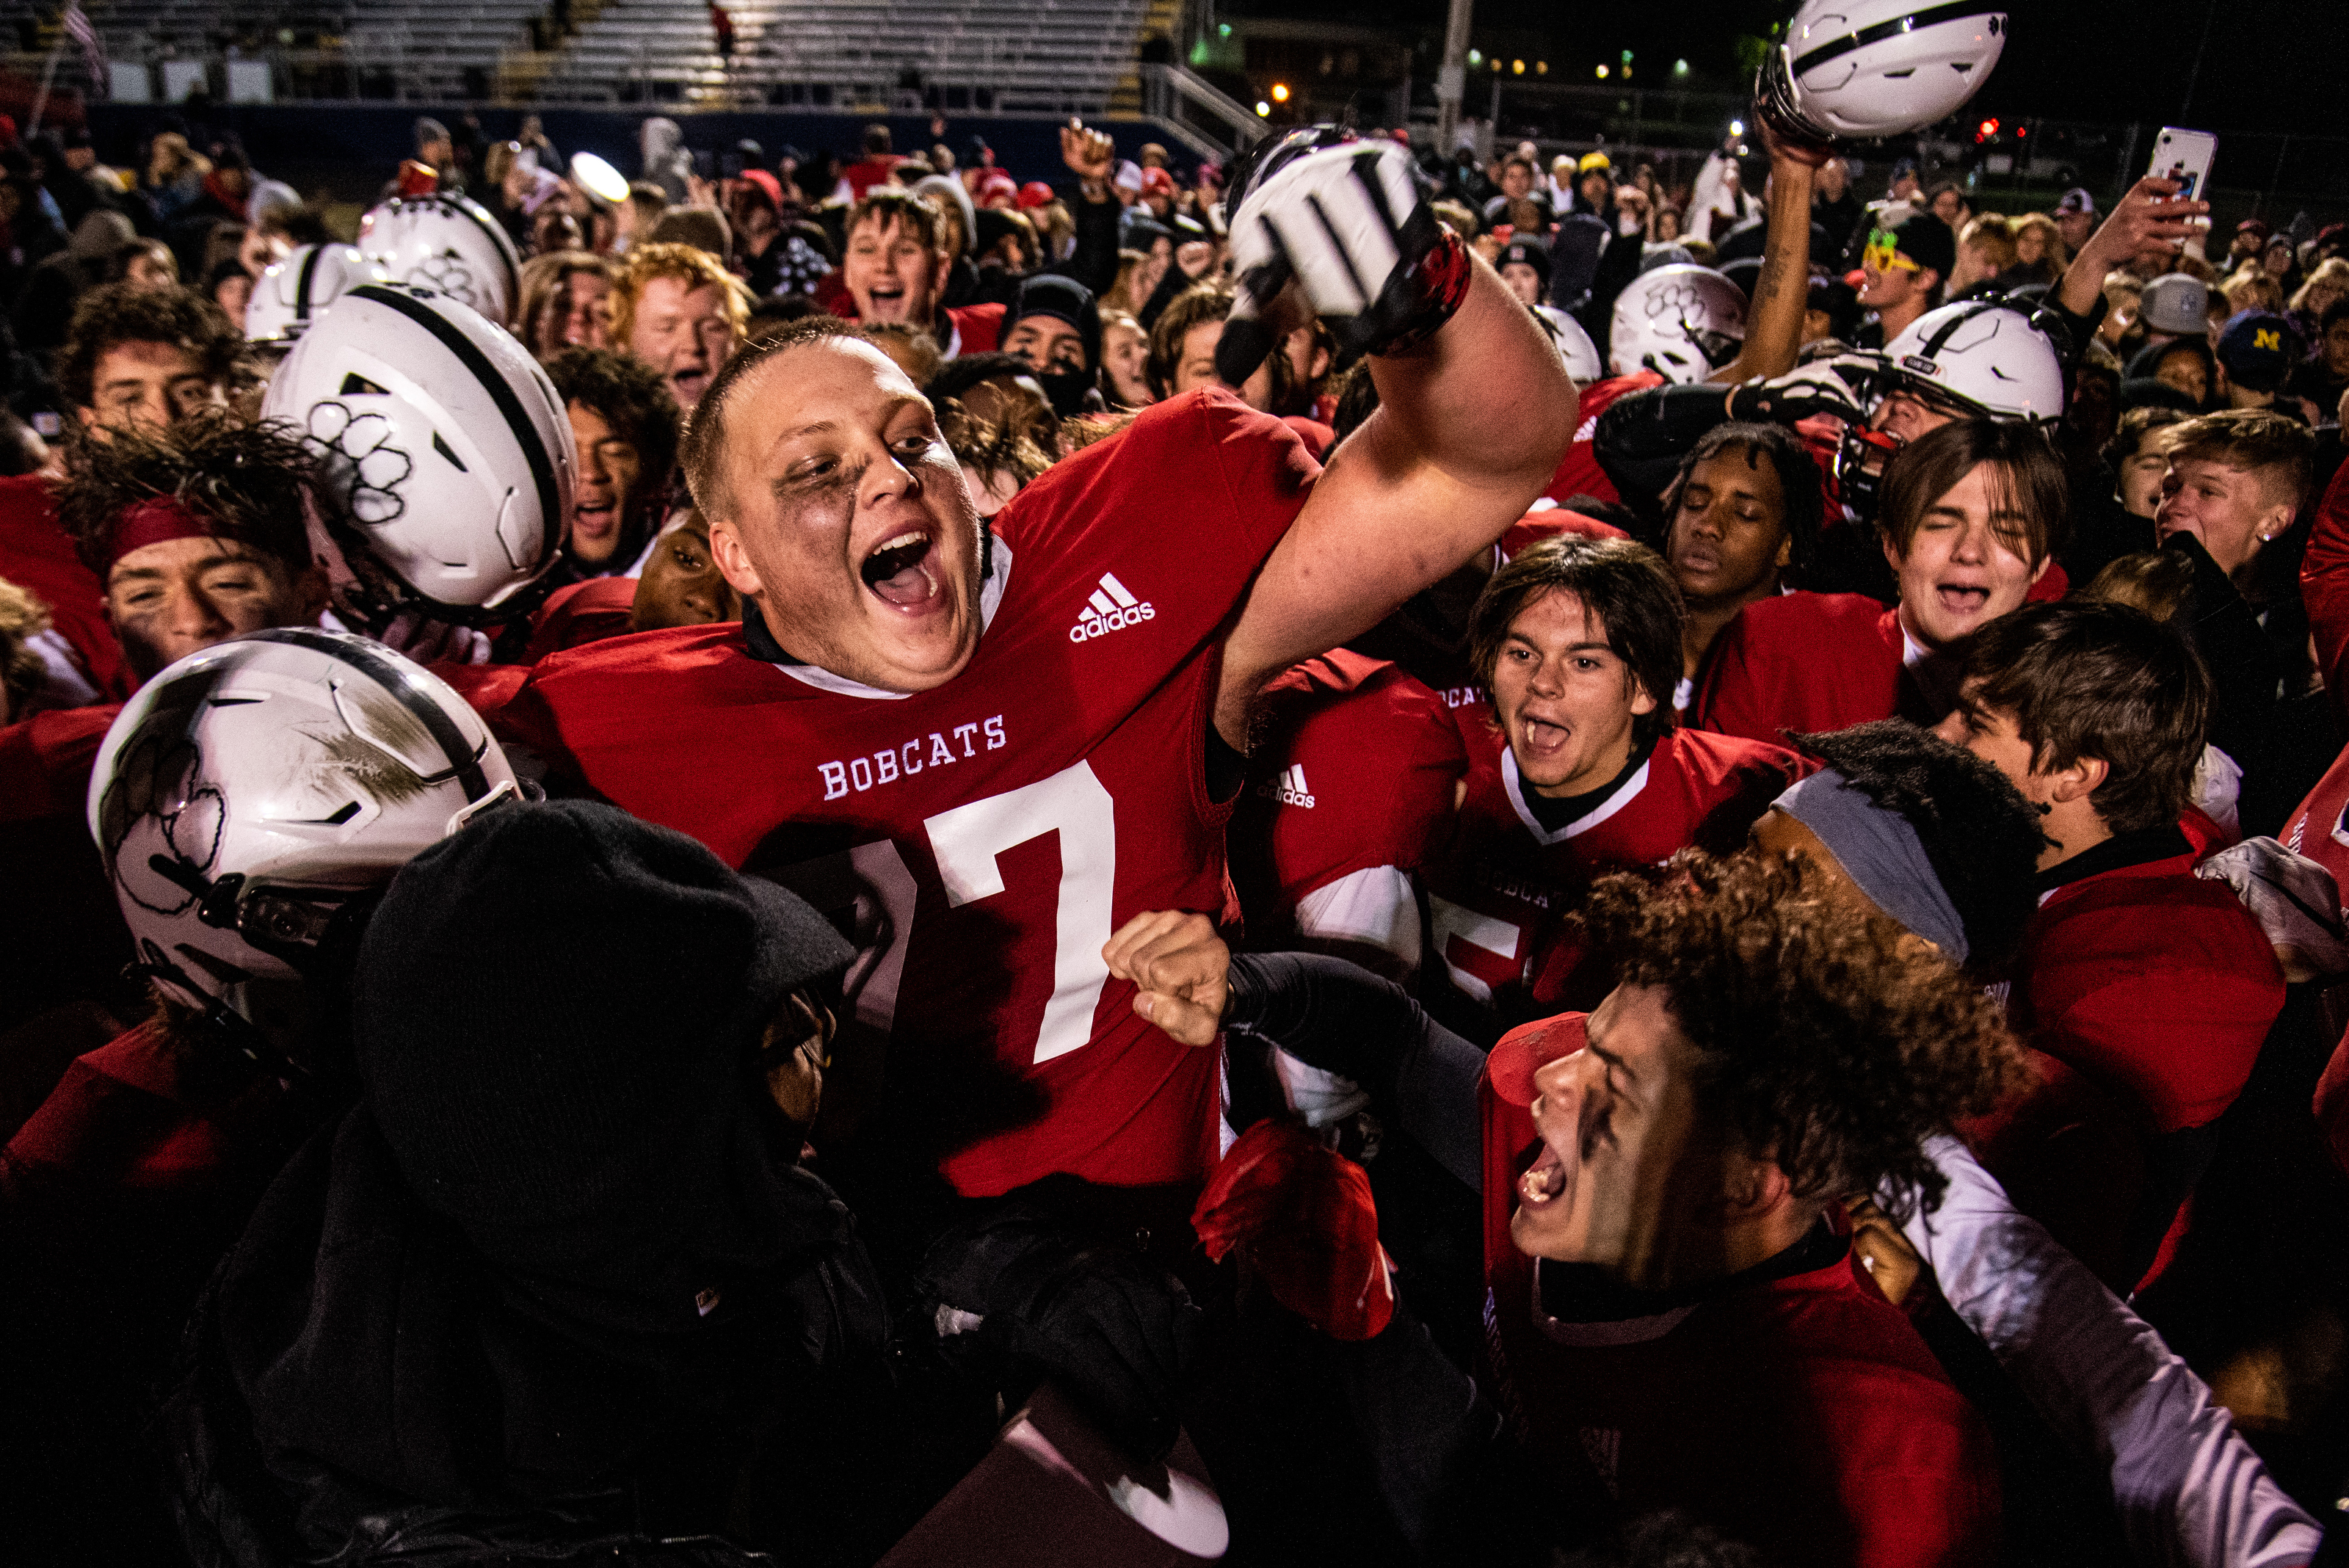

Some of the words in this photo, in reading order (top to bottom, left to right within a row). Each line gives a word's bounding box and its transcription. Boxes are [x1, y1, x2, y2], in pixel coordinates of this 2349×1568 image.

[2253, 327, 2281, 352] M
[1068, 600, 1157, 645] adidas
[816, 714, 1007, 802] BOBCATS
[1256, 784, 1316, 810] adidas
